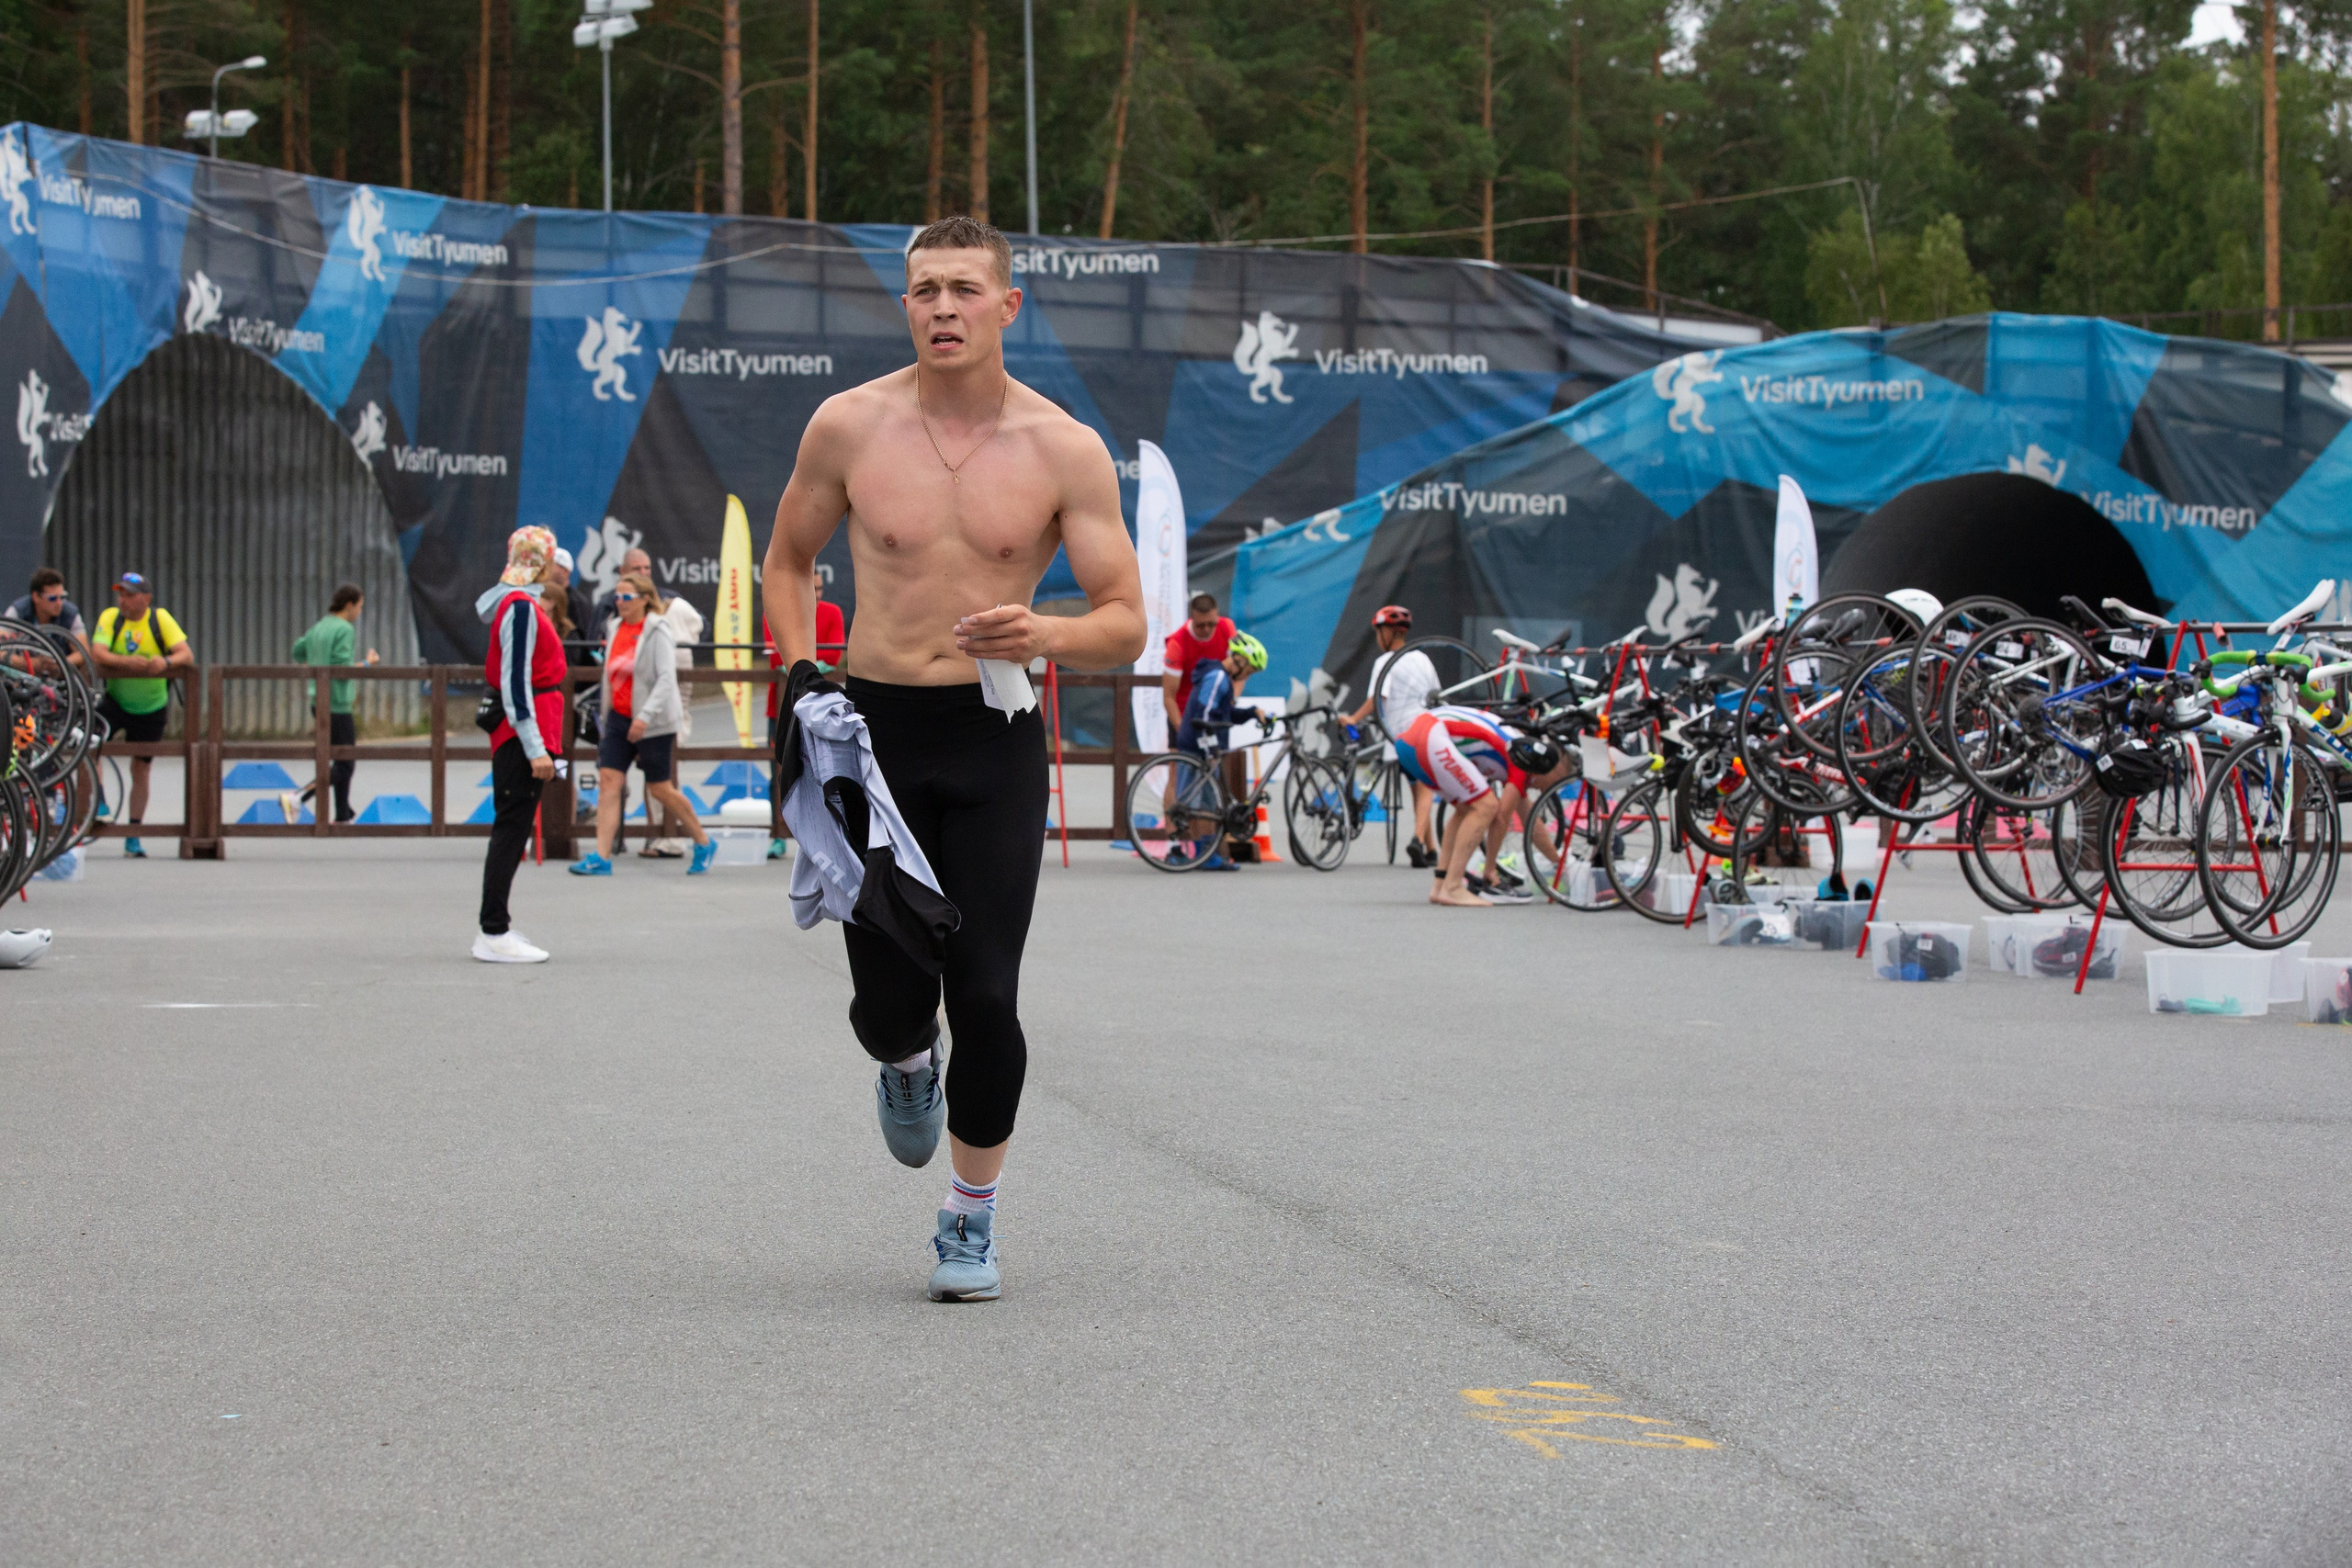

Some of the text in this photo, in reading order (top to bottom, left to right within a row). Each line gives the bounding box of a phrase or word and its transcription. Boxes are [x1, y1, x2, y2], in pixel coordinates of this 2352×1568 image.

[392, 231, 508, 267] VisitTyumen
[1012, 247, 1159, 280] sitTyumen
[657, 347, 833, 381] VisitTyumen
[1314, 347, 1488, 380] VisitTyumen
[1740, 374, 1924, 410] VisitTyumen
[392, 445, 507, 479] VisitTyumen
[1379, 481, 1567, 518] VisitTyumen
